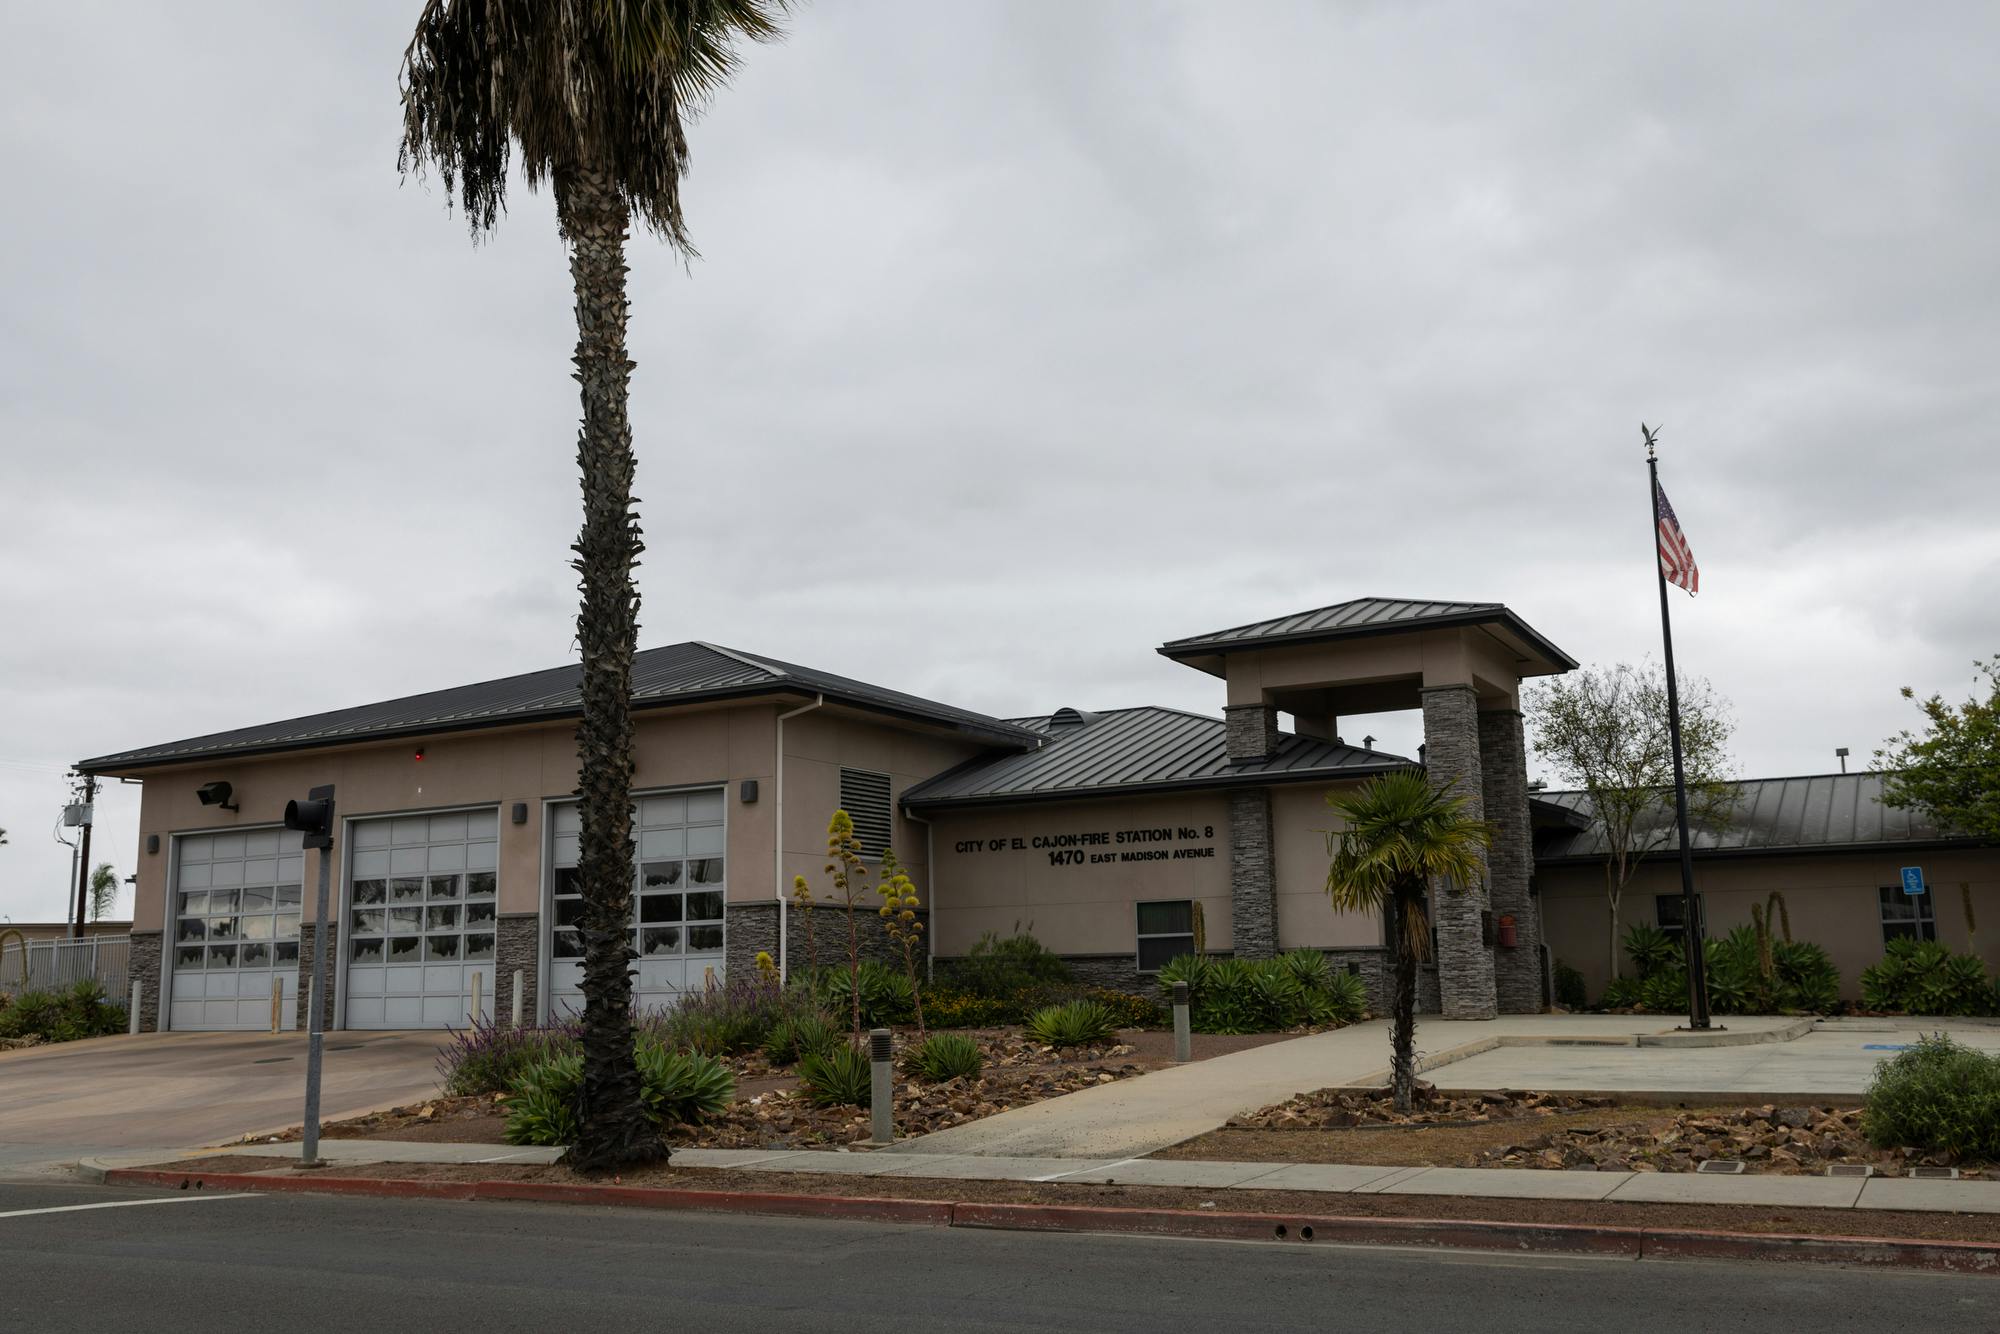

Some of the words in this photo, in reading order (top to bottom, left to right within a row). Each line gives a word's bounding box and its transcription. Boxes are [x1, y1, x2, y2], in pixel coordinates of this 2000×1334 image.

[955, 840, 984, 853] CITY
[989, 838, 1007, 851] OF
[1011, 838, 1027, 850] EL
[1032, 832, 1110, 848] CAJON-FIRE
[1116, 828, 1172, 844] STATION
[1178, 827, 1200, 839] No.
[1204, 826, 1214, 838] 8
[1048, 850, 1085, 866] 1470
[1090, 853, 1117, 864] EAST
[1121, 850, 1169, 862] MADISON
[1173, 847, 1215, 859] AVENUE
